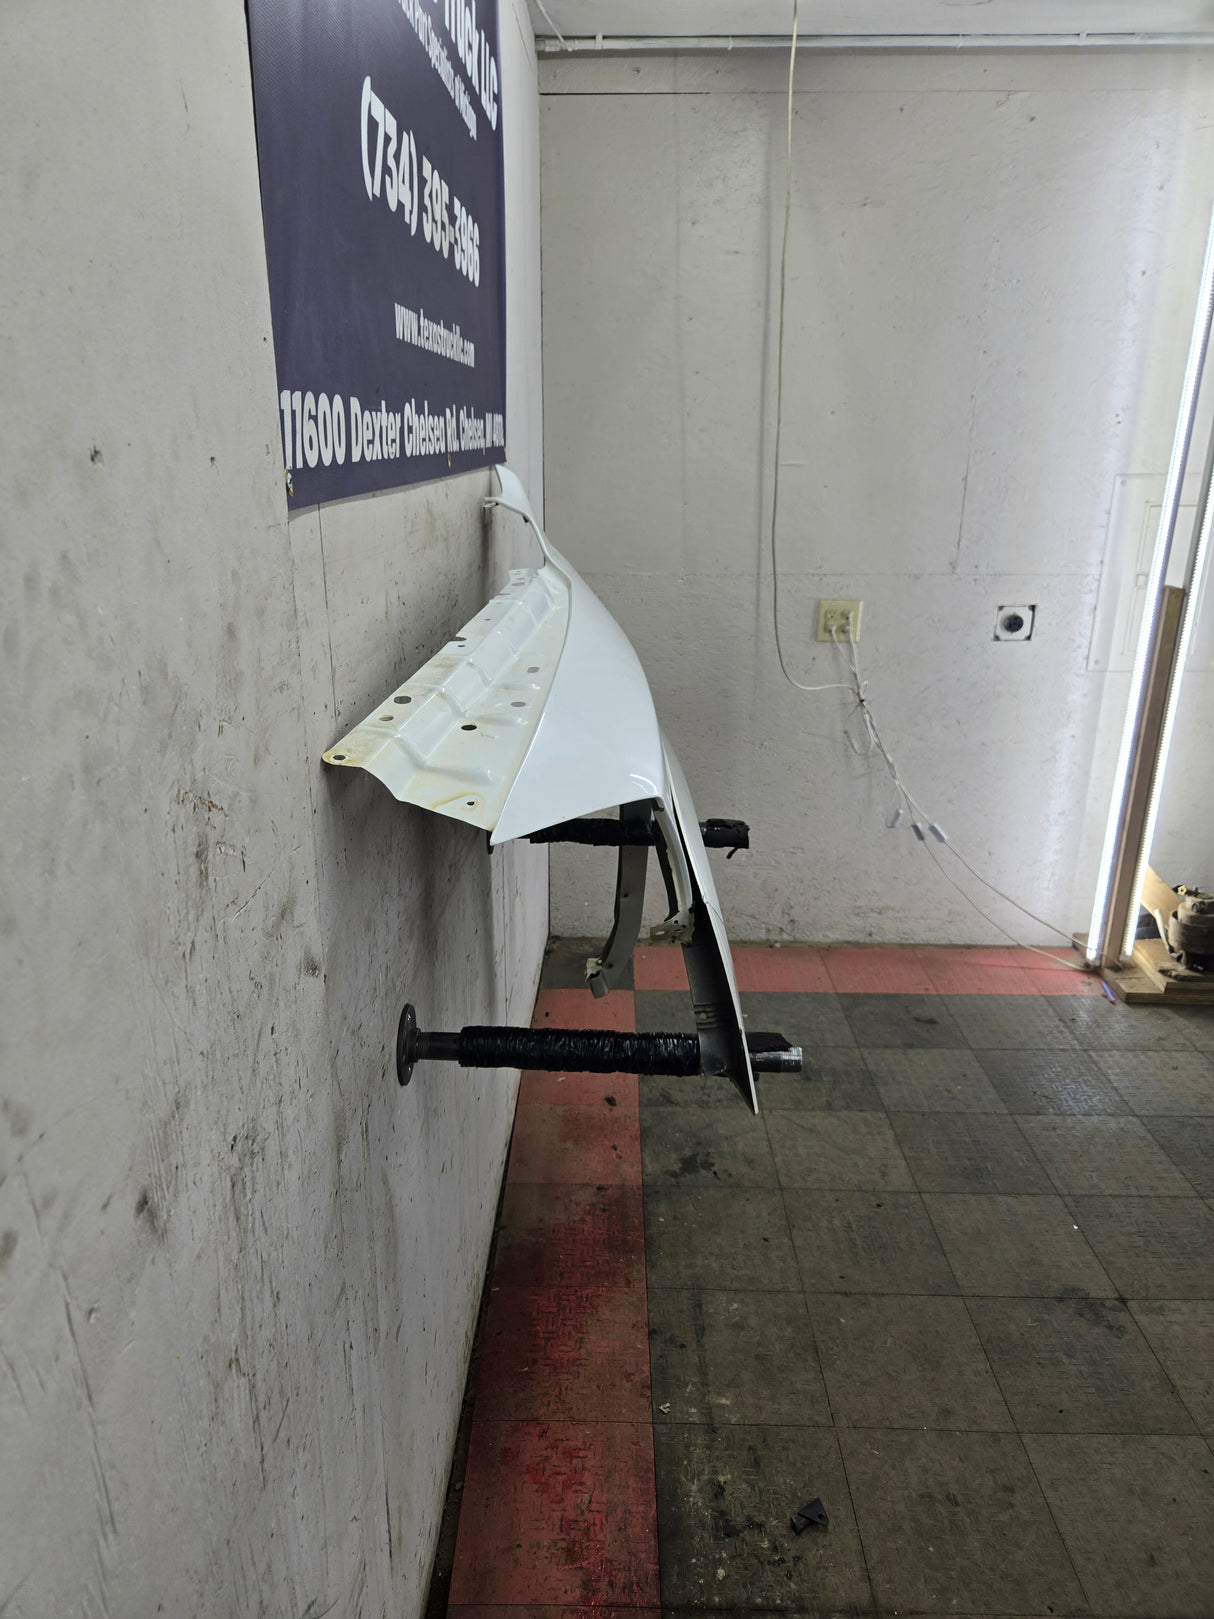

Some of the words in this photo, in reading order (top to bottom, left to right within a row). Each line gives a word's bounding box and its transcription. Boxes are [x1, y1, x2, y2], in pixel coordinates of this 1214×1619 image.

[481, 29, 498, 131] LLC
[361, 76, 418, 236] (734)
[422, 155, 480, 287] 395-3966
[280, 389, 346, 470] 11600
[350, 396, 401, 463] Dexter
[404, 398, 445, 457] Chelsea
[445, 405, 459, 453] Rd.
